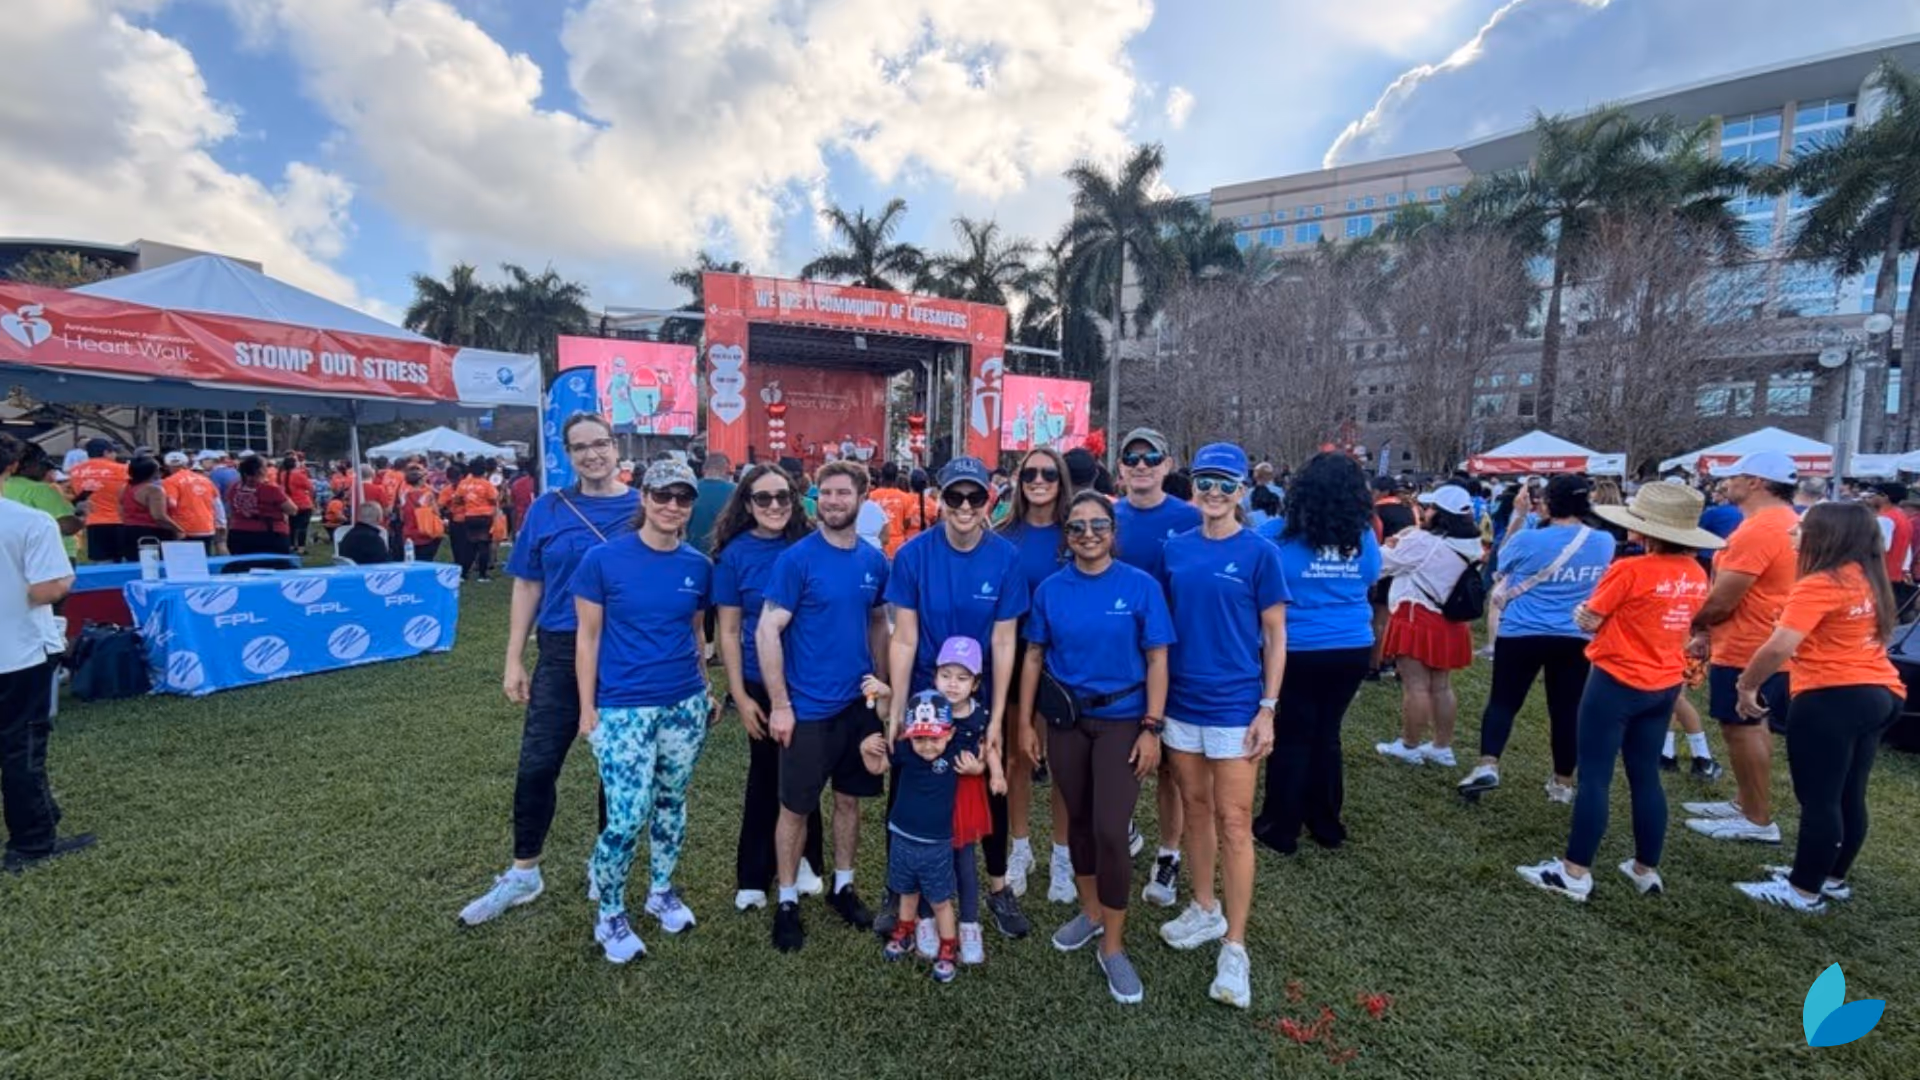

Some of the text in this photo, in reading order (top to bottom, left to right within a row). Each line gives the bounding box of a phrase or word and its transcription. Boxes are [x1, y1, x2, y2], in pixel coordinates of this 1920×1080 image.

[756, 289, 777, 308] WE
[805, 294, 816, 310] A
[817, 294, 887, 318] COMMUNITY
[889, 302, 906, 320] OF
[907, 304, 968, 329] LIFESAVERS
[113, 328, 140, 339] Heart
[63, 332, 131, 356] Heart
[234, 341, 430, 385] STOMP OUT STRESS
[1544, 565, 1604, 583] TAFF
[305, 601, 351, 617] FPL
[384, 593, 424, 608] FPL
[213, 611, 268, 630] FPL
